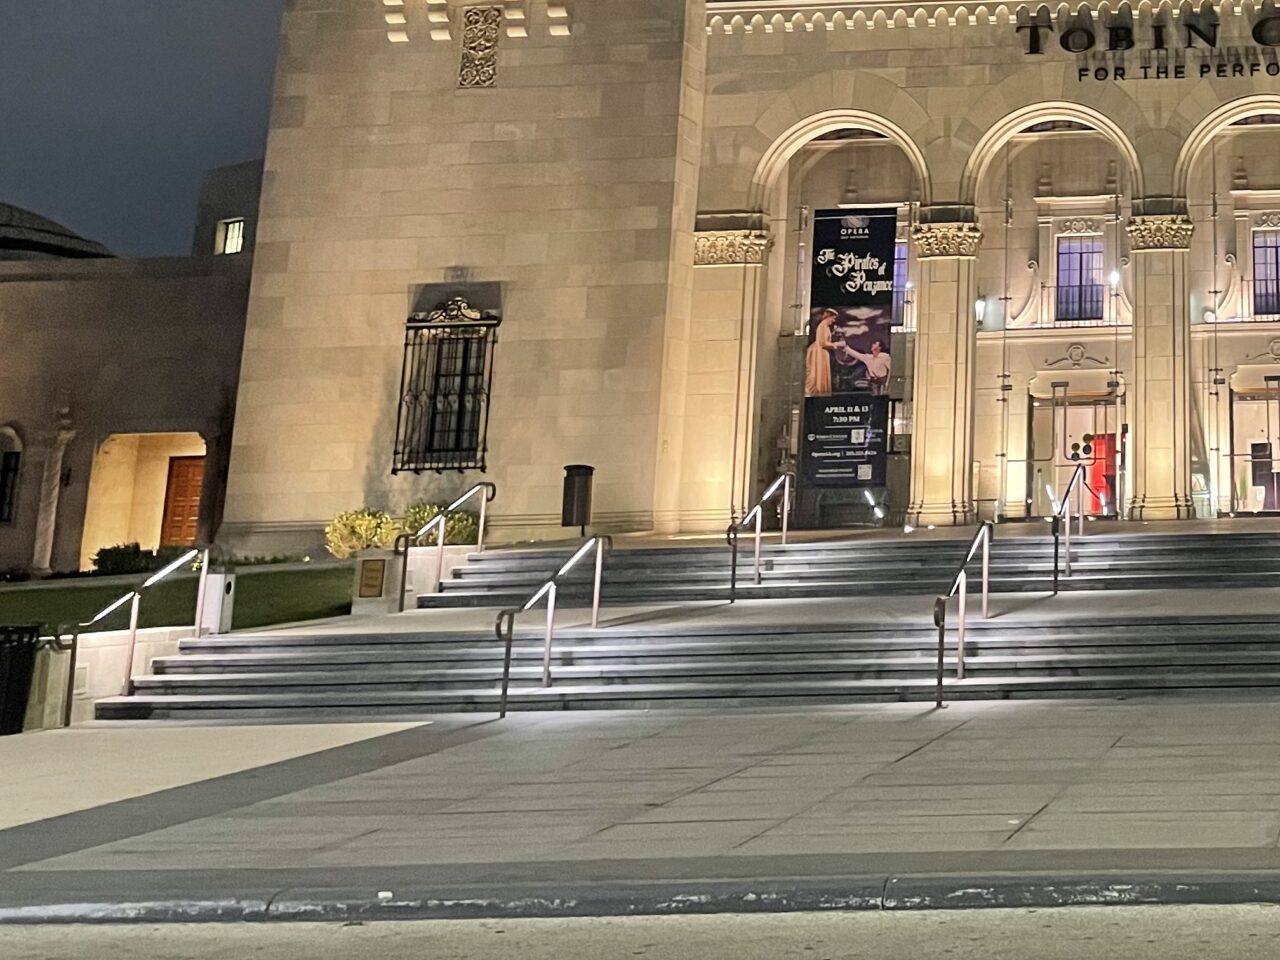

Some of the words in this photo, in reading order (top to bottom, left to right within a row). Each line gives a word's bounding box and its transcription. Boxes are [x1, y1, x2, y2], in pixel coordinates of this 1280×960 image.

[1016, 22, 1220, 55] TOBIN
[1078, 67, 1126, 82] FOR
[1140, 65, 1186, 80] THE
[831, 252, 879, 276] Pirates
[845, 270, 893, 296] Penzance
